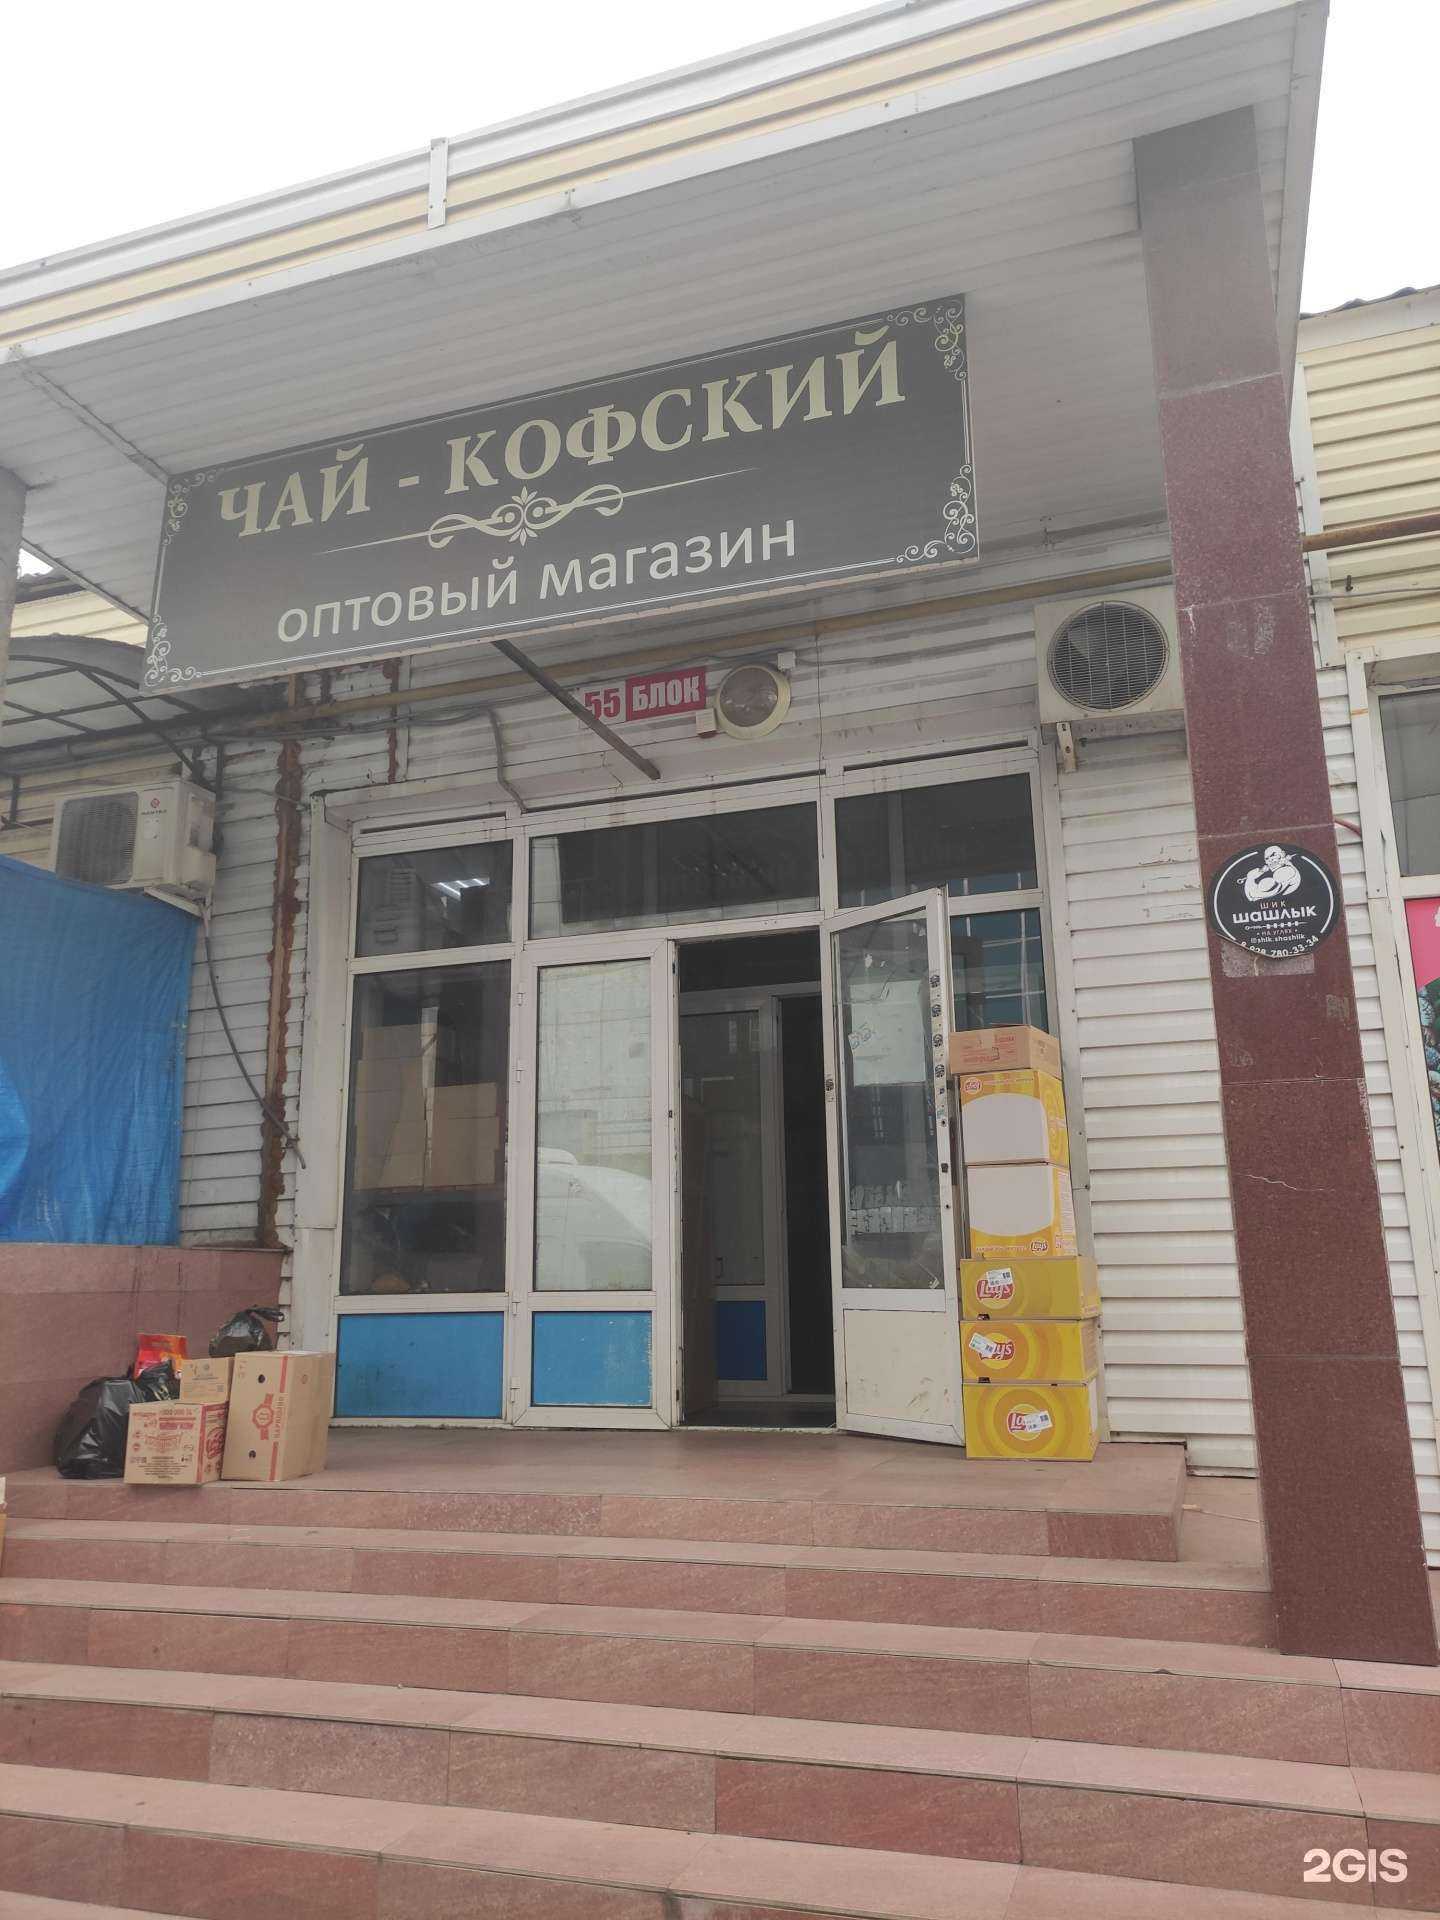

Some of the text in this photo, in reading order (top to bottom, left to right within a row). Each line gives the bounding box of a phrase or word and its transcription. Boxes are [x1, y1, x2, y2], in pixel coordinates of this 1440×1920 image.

[217, 443, 371, 537] ЧАЙ
[444, 325, 906, 495] КОФСКИЙ
[277, 519, 796, 643] оптовый магазин
[585, 675, 700, 720] 55 БЛОК
